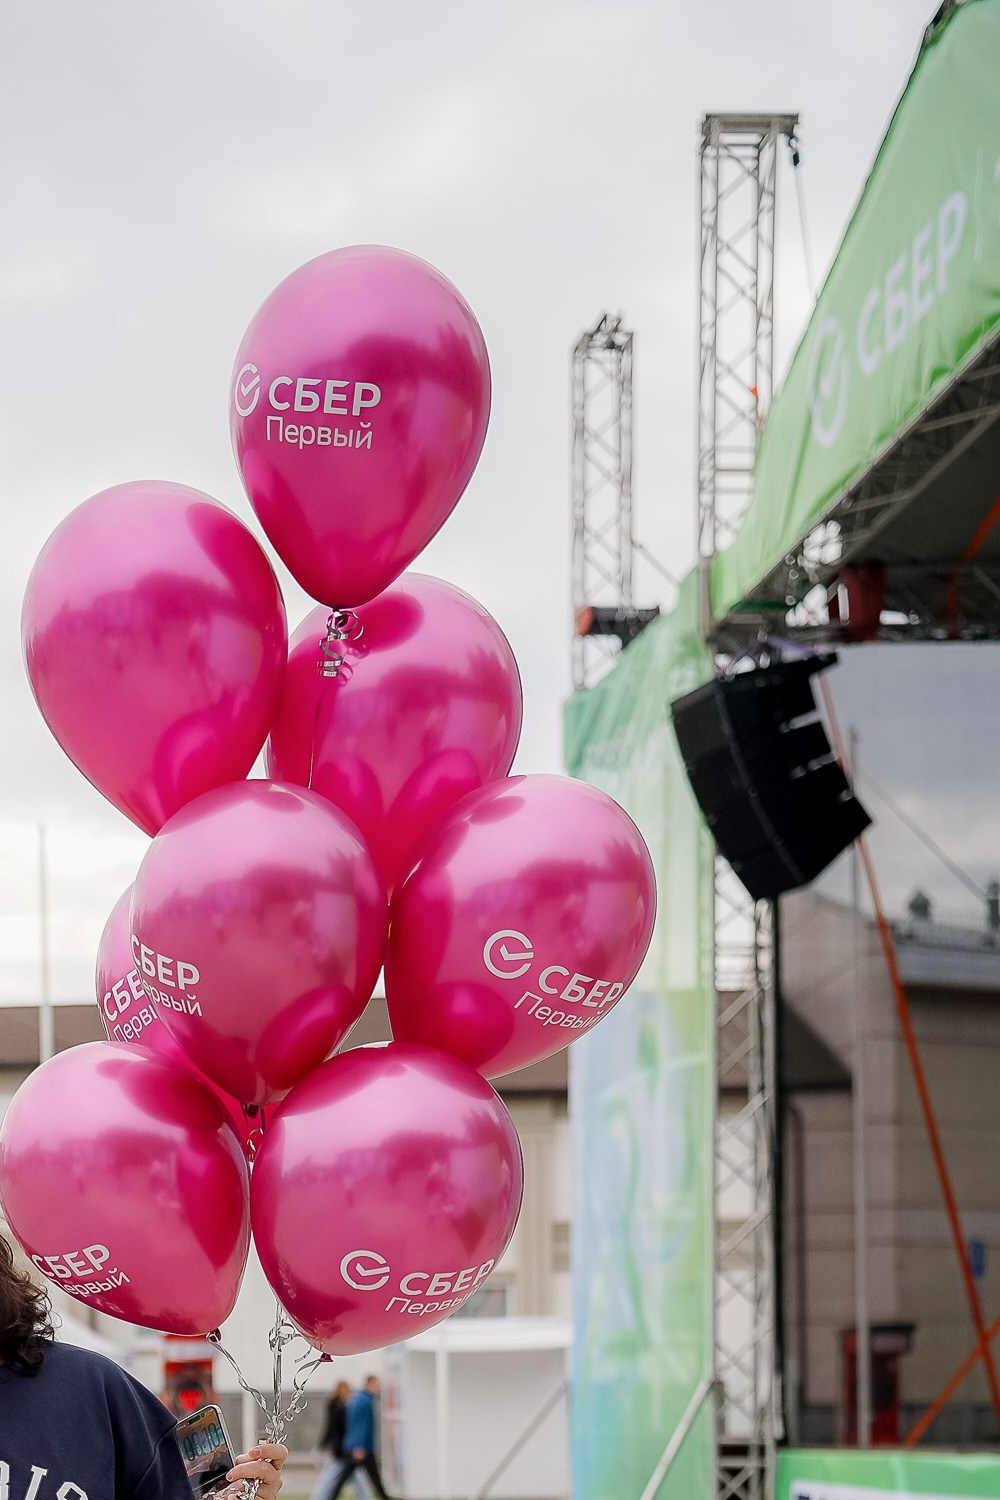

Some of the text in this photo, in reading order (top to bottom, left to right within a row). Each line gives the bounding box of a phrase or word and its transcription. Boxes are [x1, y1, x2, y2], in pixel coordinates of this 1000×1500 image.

[857, 191, 968, 376] СБЕР
[268, 376, 382, 416] СБЕР
[265, 415, 374, 450] Первый
[131, 934, 200, 991] СБЕР
[103, 968, 147, 1022] СБЕ
[142, 978, 203, 1017] ервый
[538, 965, 624, 1008] СБЕР
[513, 991, 604, 1029] Первый
[31, 1244, 110, 1279] СБЕР
[400, 1258, 495, 1297] СБЕР
